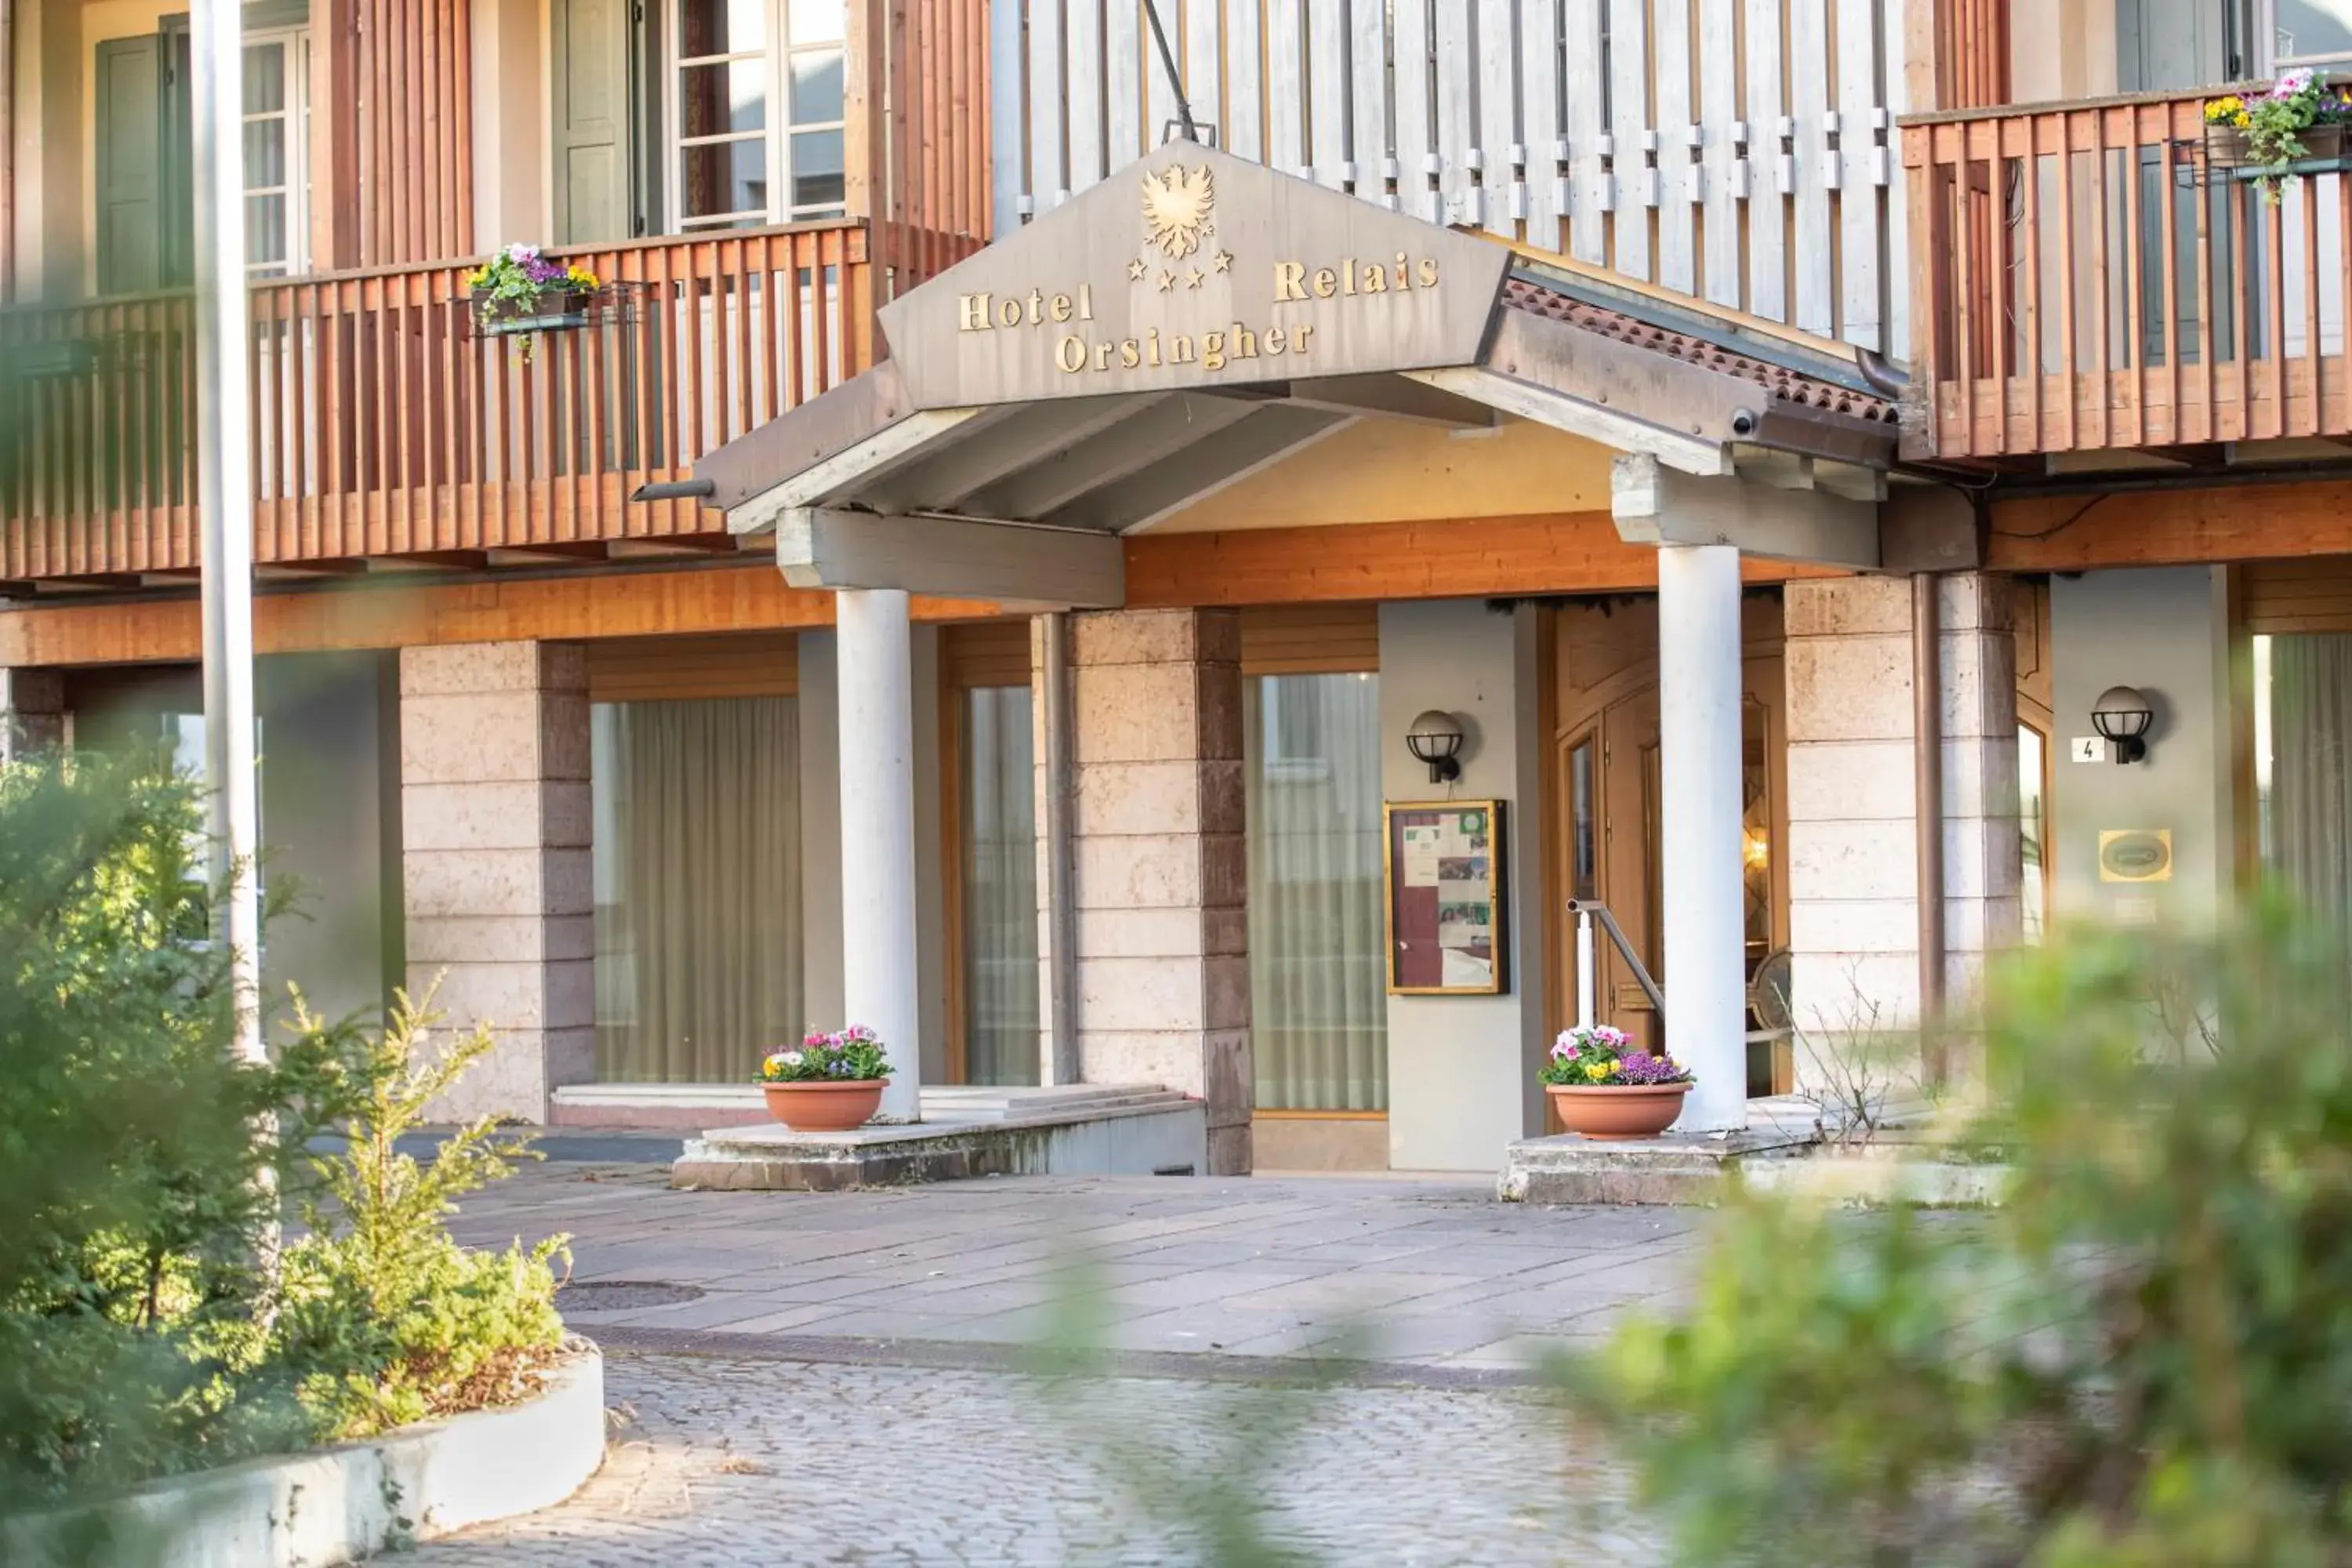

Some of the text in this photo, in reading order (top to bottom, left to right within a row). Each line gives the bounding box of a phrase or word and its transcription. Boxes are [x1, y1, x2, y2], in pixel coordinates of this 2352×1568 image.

[960, 252, 1439, 331] Hotel Relais
[1054, 322, 1313, 373] Orsingher
[2083, 740, 2093, 758] 4
